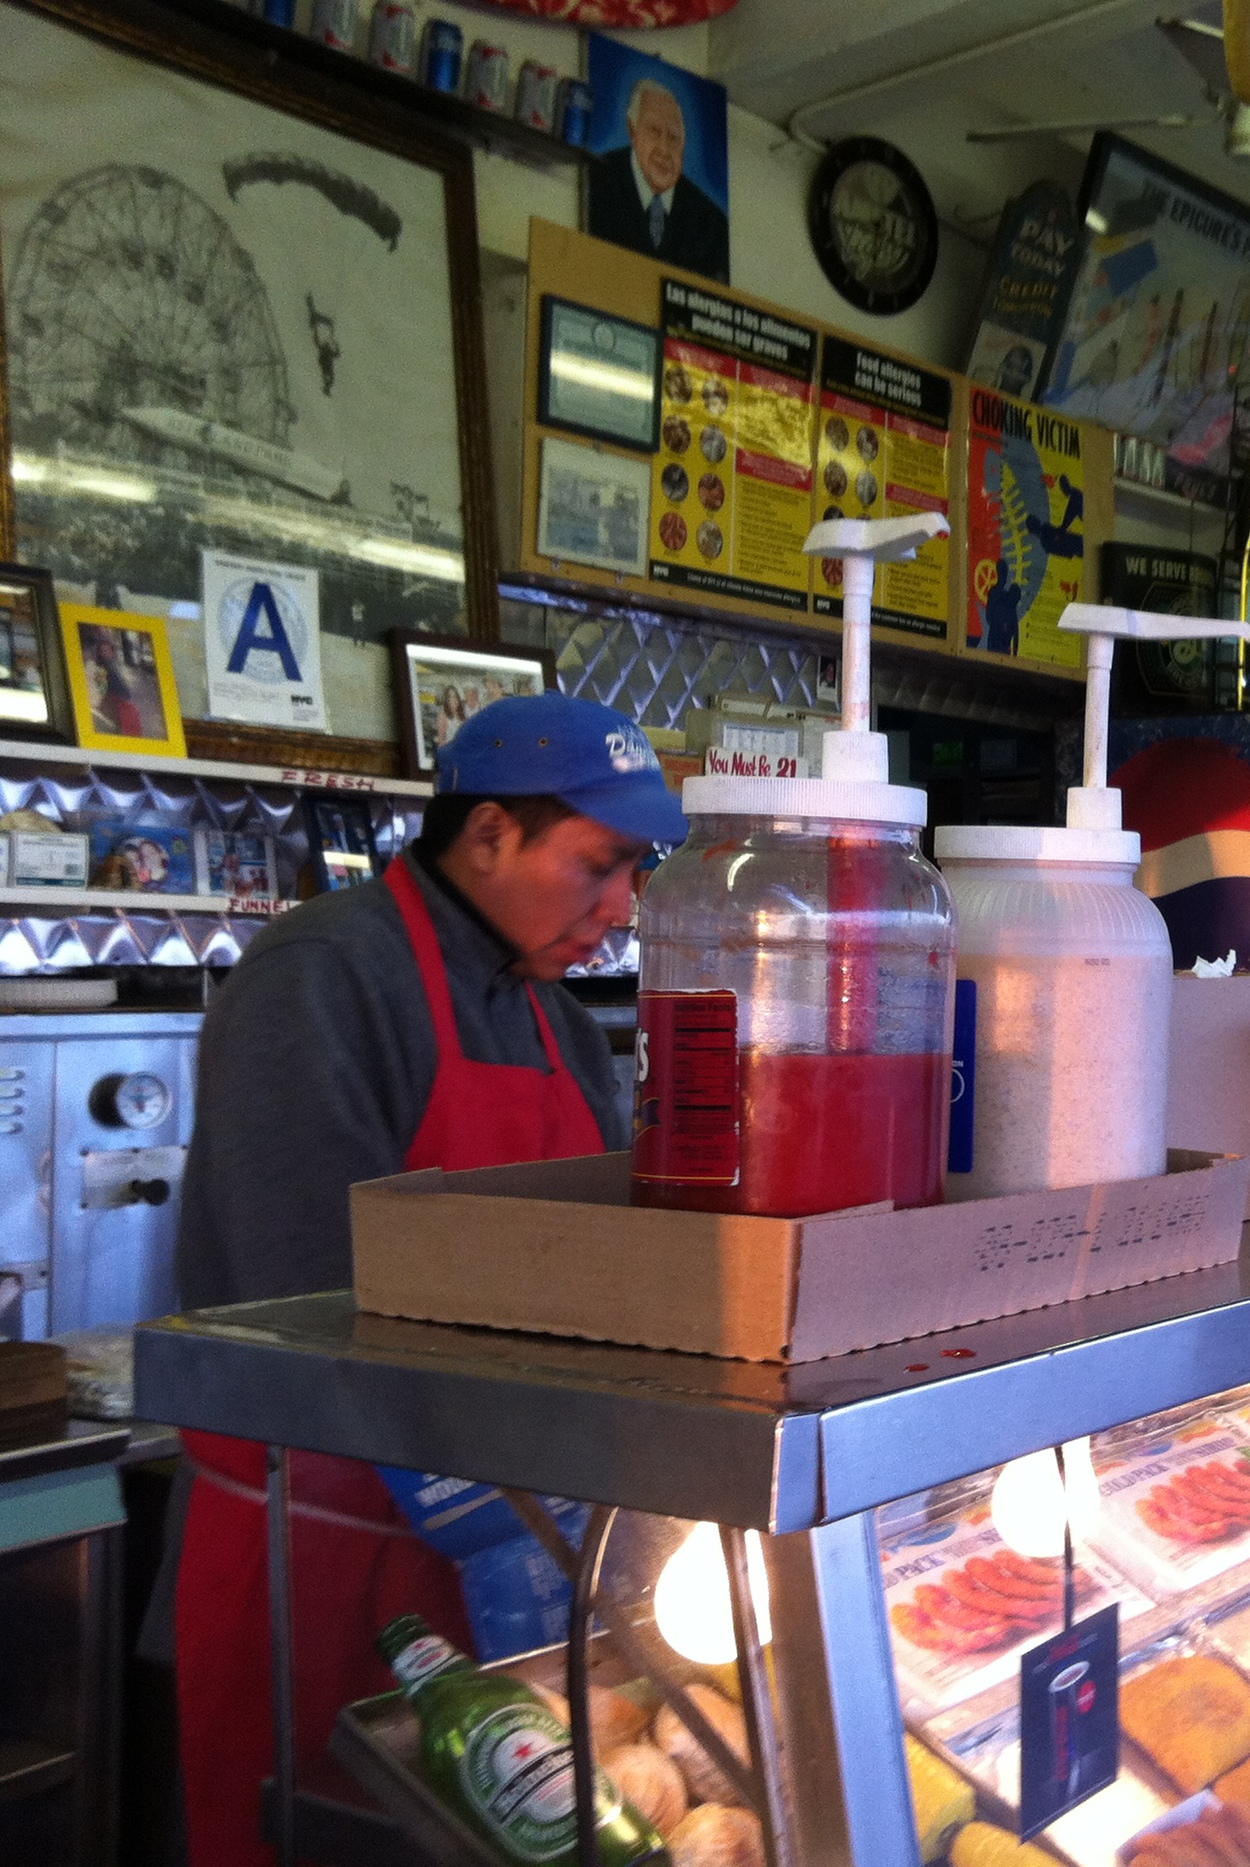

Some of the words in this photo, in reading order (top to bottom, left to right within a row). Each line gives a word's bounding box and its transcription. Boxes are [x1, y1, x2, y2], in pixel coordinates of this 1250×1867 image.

[1020, 217, 1075, 257] PAY
[1011, 241, 1067, 280] TODAY
[856, 350, 880, 374] Food
[972, 389, 1033, 444] CHOKING
[1036, 412, 1081, 460] VICTIM
[1125, 556, 1148, 576] WE
[1152, 559, 1187, 581] SERVE
[227, 582, 303, 683] A
[281, 769, 375, 791] FRESH
[709, 750, 729, 777] You
[730, 750, 757, 778] Must
[758, 754, 772, 777] Be
[776, 757, 798, 778] 21
